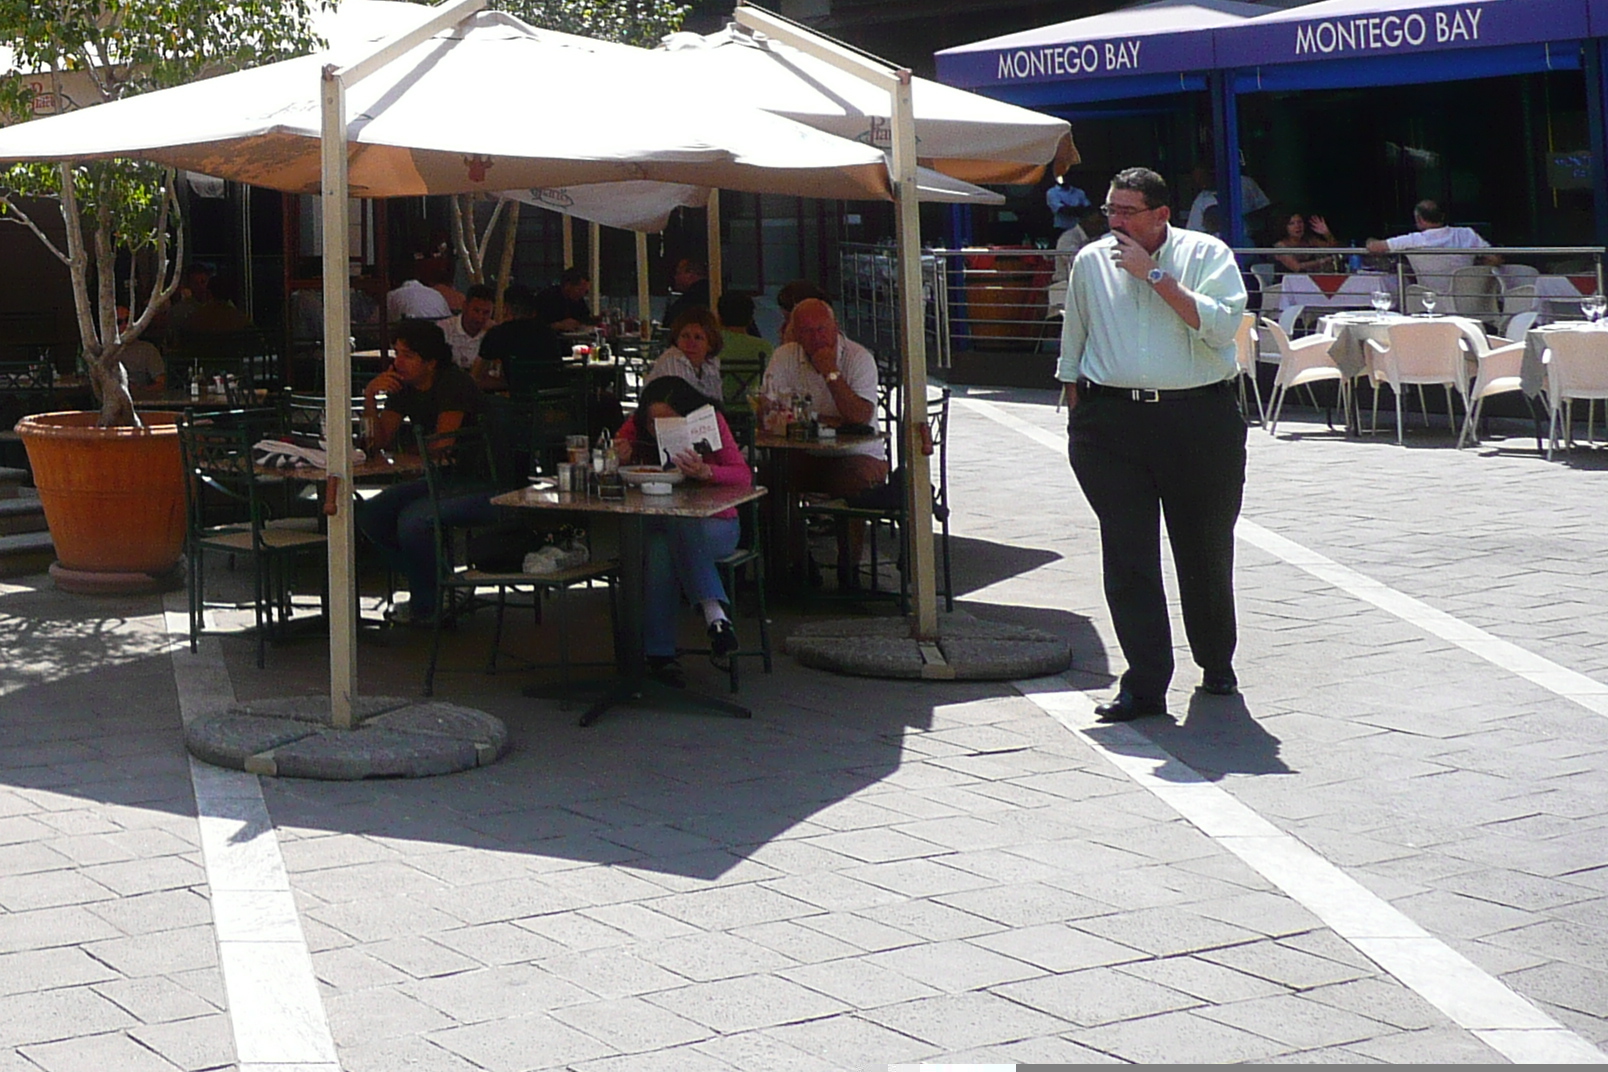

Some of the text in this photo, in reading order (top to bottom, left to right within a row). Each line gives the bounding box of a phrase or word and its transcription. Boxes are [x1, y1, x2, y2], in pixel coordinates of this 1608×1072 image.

[1295, 8, 1483, 55] MONTEGO BAY
[998, 40, 1141, 79] MONTEGO BAY
